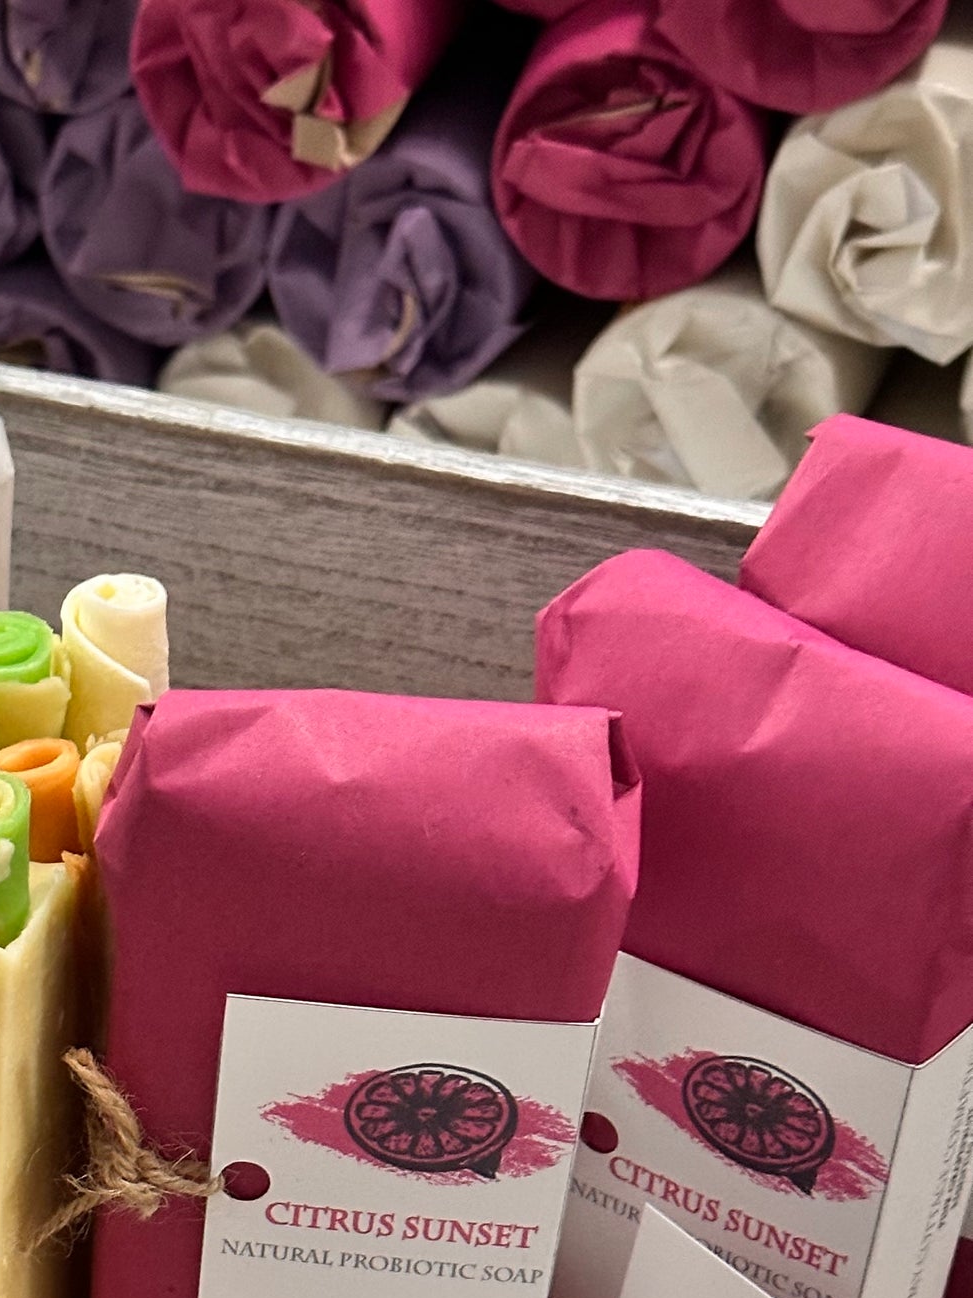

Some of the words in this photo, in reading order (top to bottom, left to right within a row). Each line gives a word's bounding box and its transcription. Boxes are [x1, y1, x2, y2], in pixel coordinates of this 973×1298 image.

[570, 1177, 641, 1224] NATUR
[609, 1156, 720, 1223] CITRUS
[724, 1208, 848, 1276] SUNSET
[264, 1201, 396, 1240] CITRUS
[401, 1215, 539, 1250] SUNSET
[220, 1238, 333, 1268] NATURAL
[339, 1251, 477, 1281] PROBIOTIC
[480, 1264, 544, 1286] SOAP
